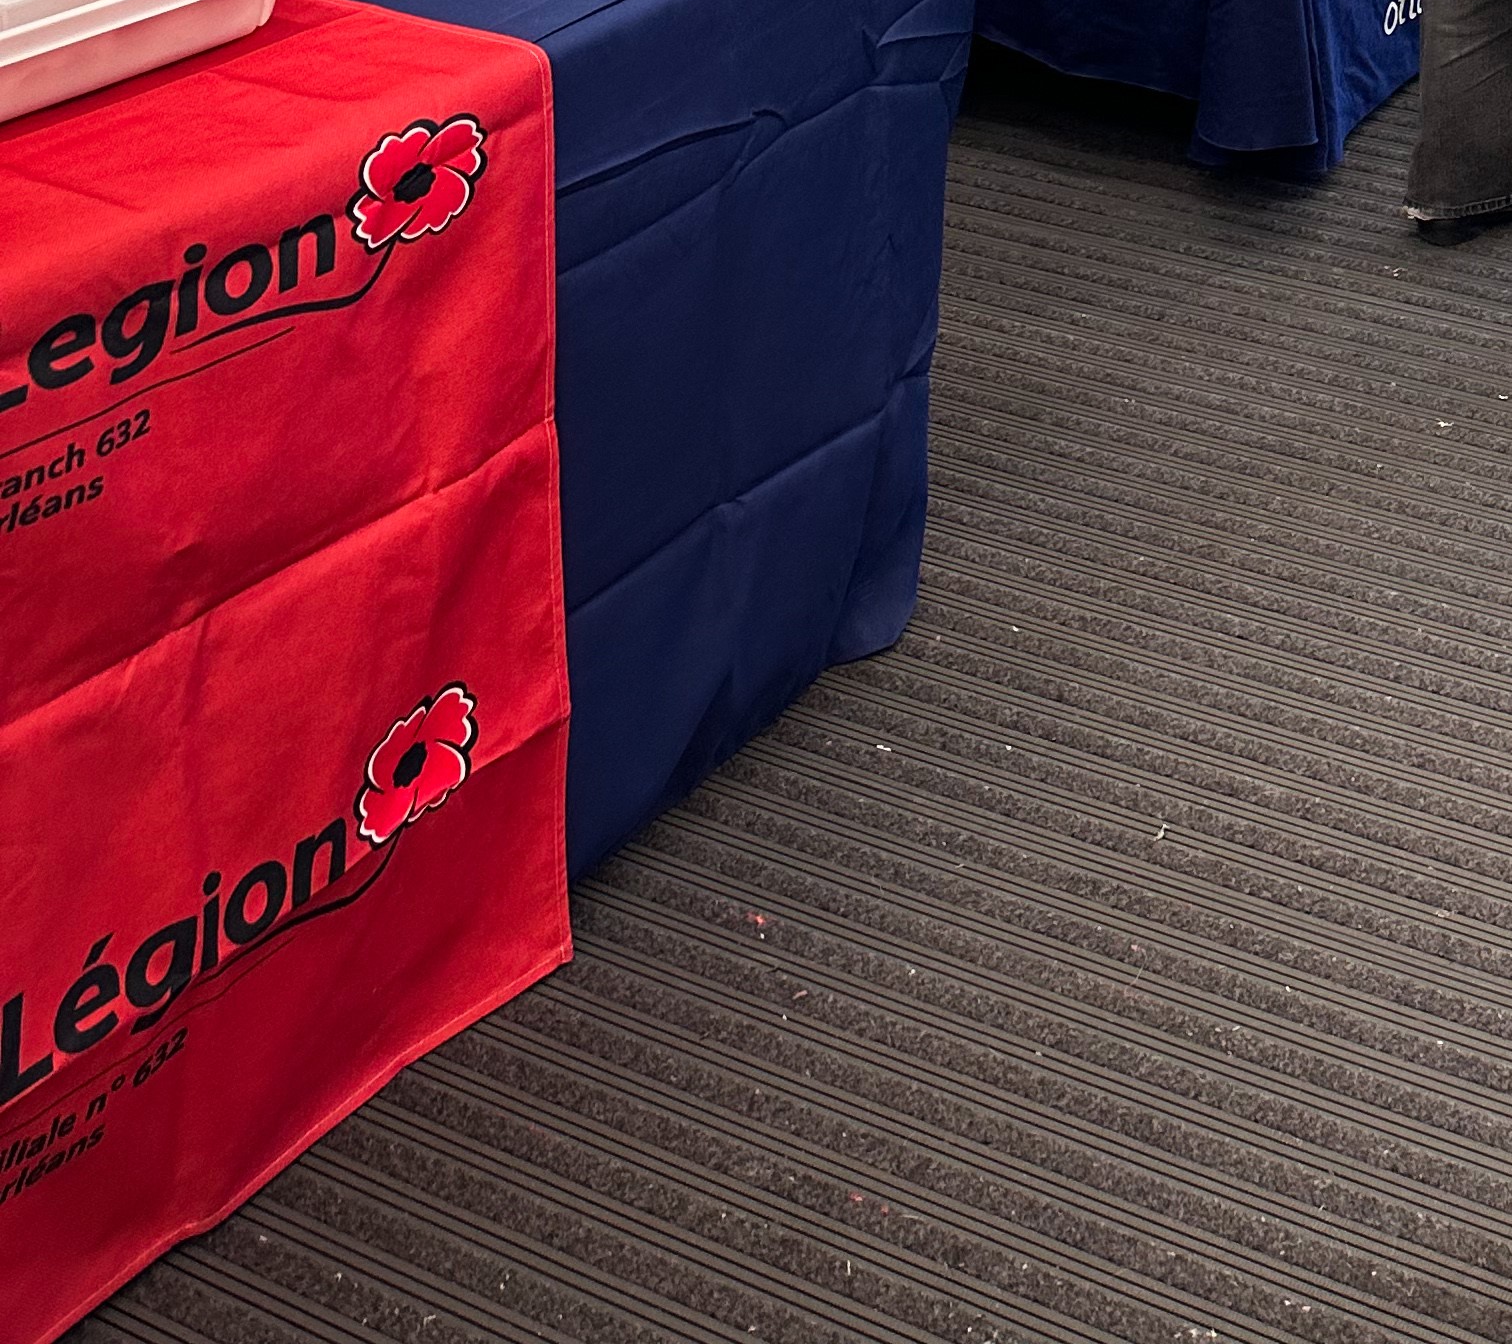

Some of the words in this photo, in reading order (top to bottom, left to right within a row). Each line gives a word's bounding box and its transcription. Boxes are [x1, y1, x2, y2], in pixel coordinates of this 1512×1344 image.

[0, 441, 85, 498] anch
[95, 408, 152, 459] 632
[0, 817, 348, 1108] Légion
[131, 1026, 189, 1089] 632
